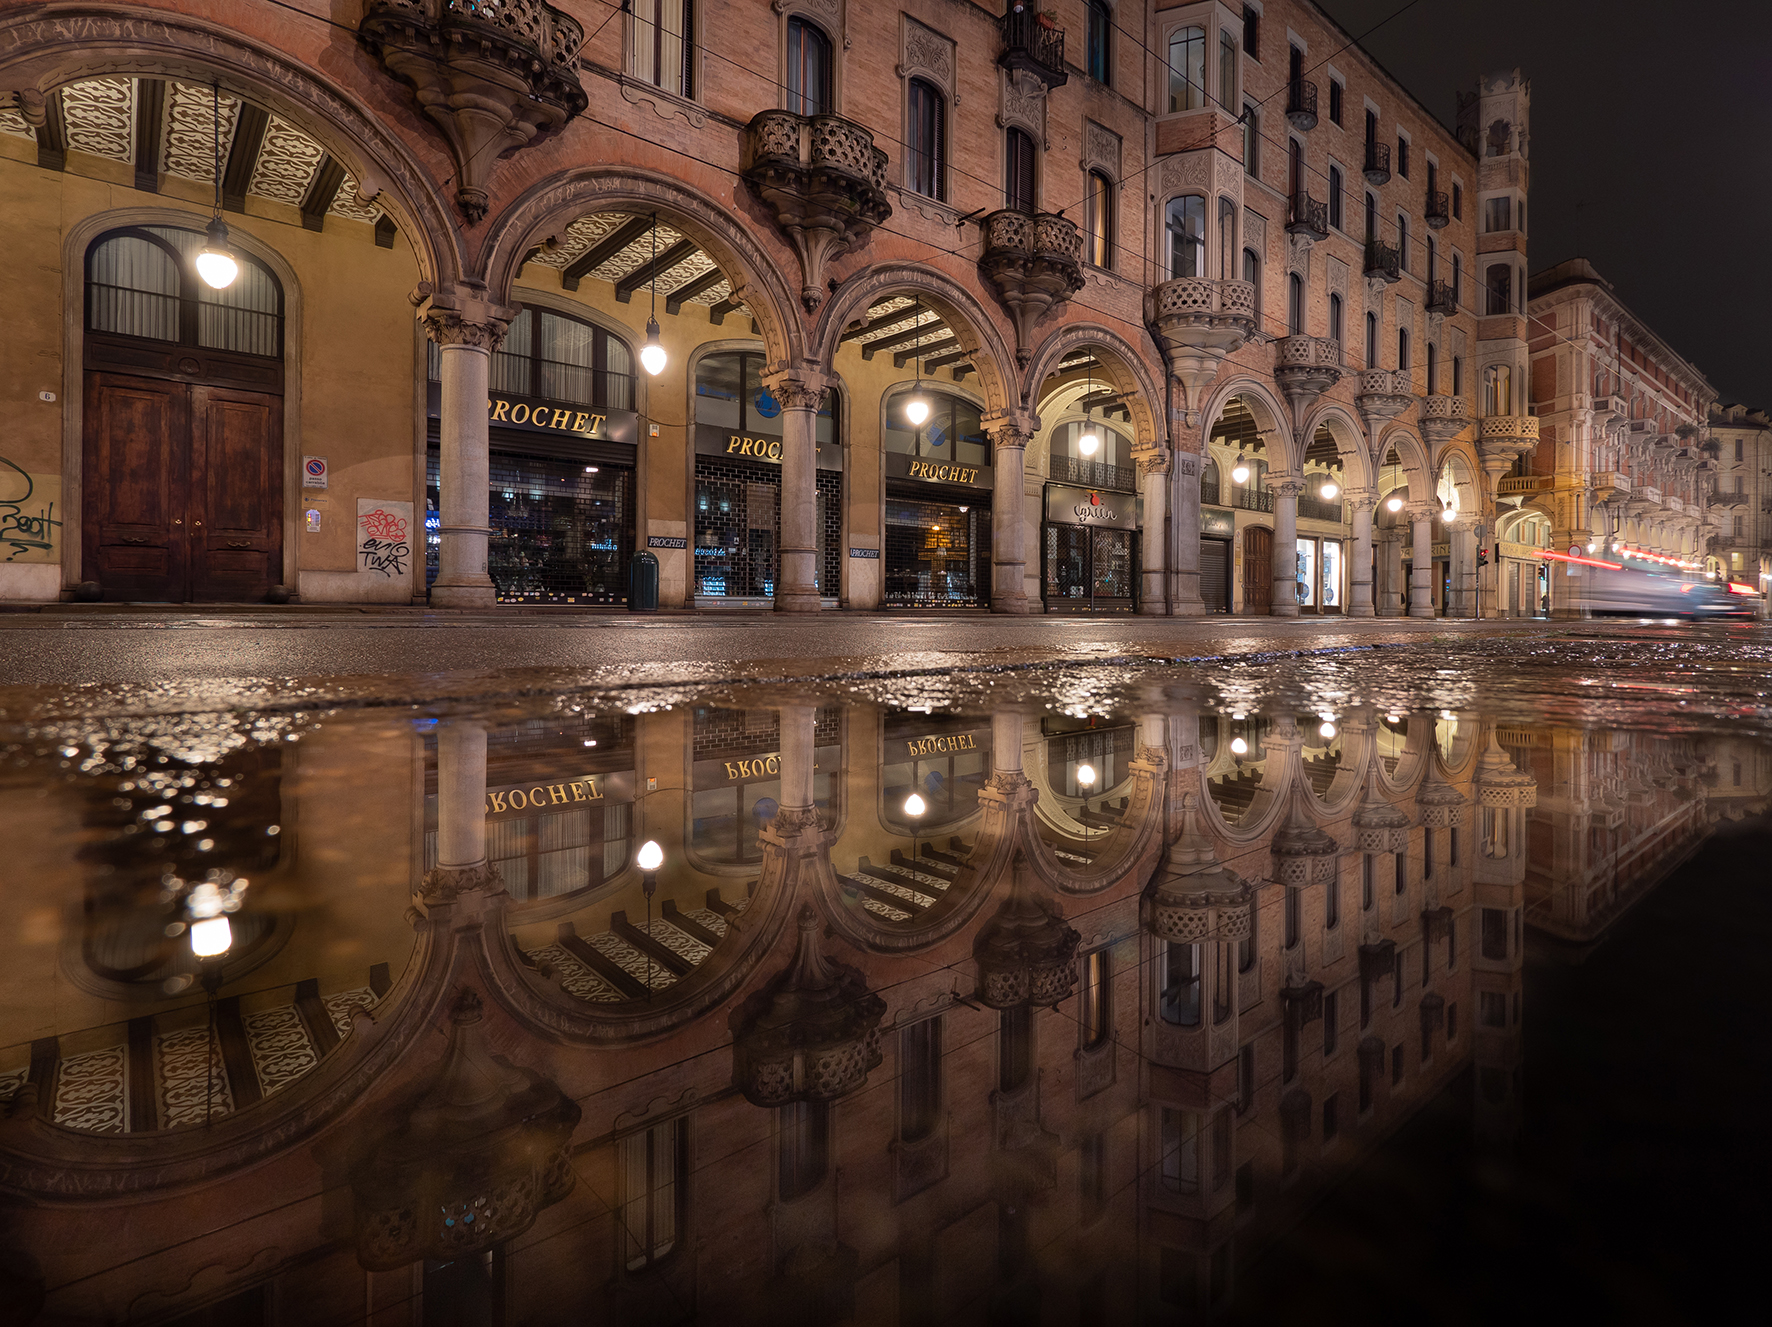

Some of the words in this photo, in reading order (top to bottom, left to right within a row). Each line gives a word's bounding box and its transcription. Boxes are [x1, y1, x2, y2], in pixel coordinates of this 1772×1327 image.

[727, 435, 821, 460] PROC
[909, 460, 978, 484] PROCHET
[648, 537, 687, 548] PROCHET
